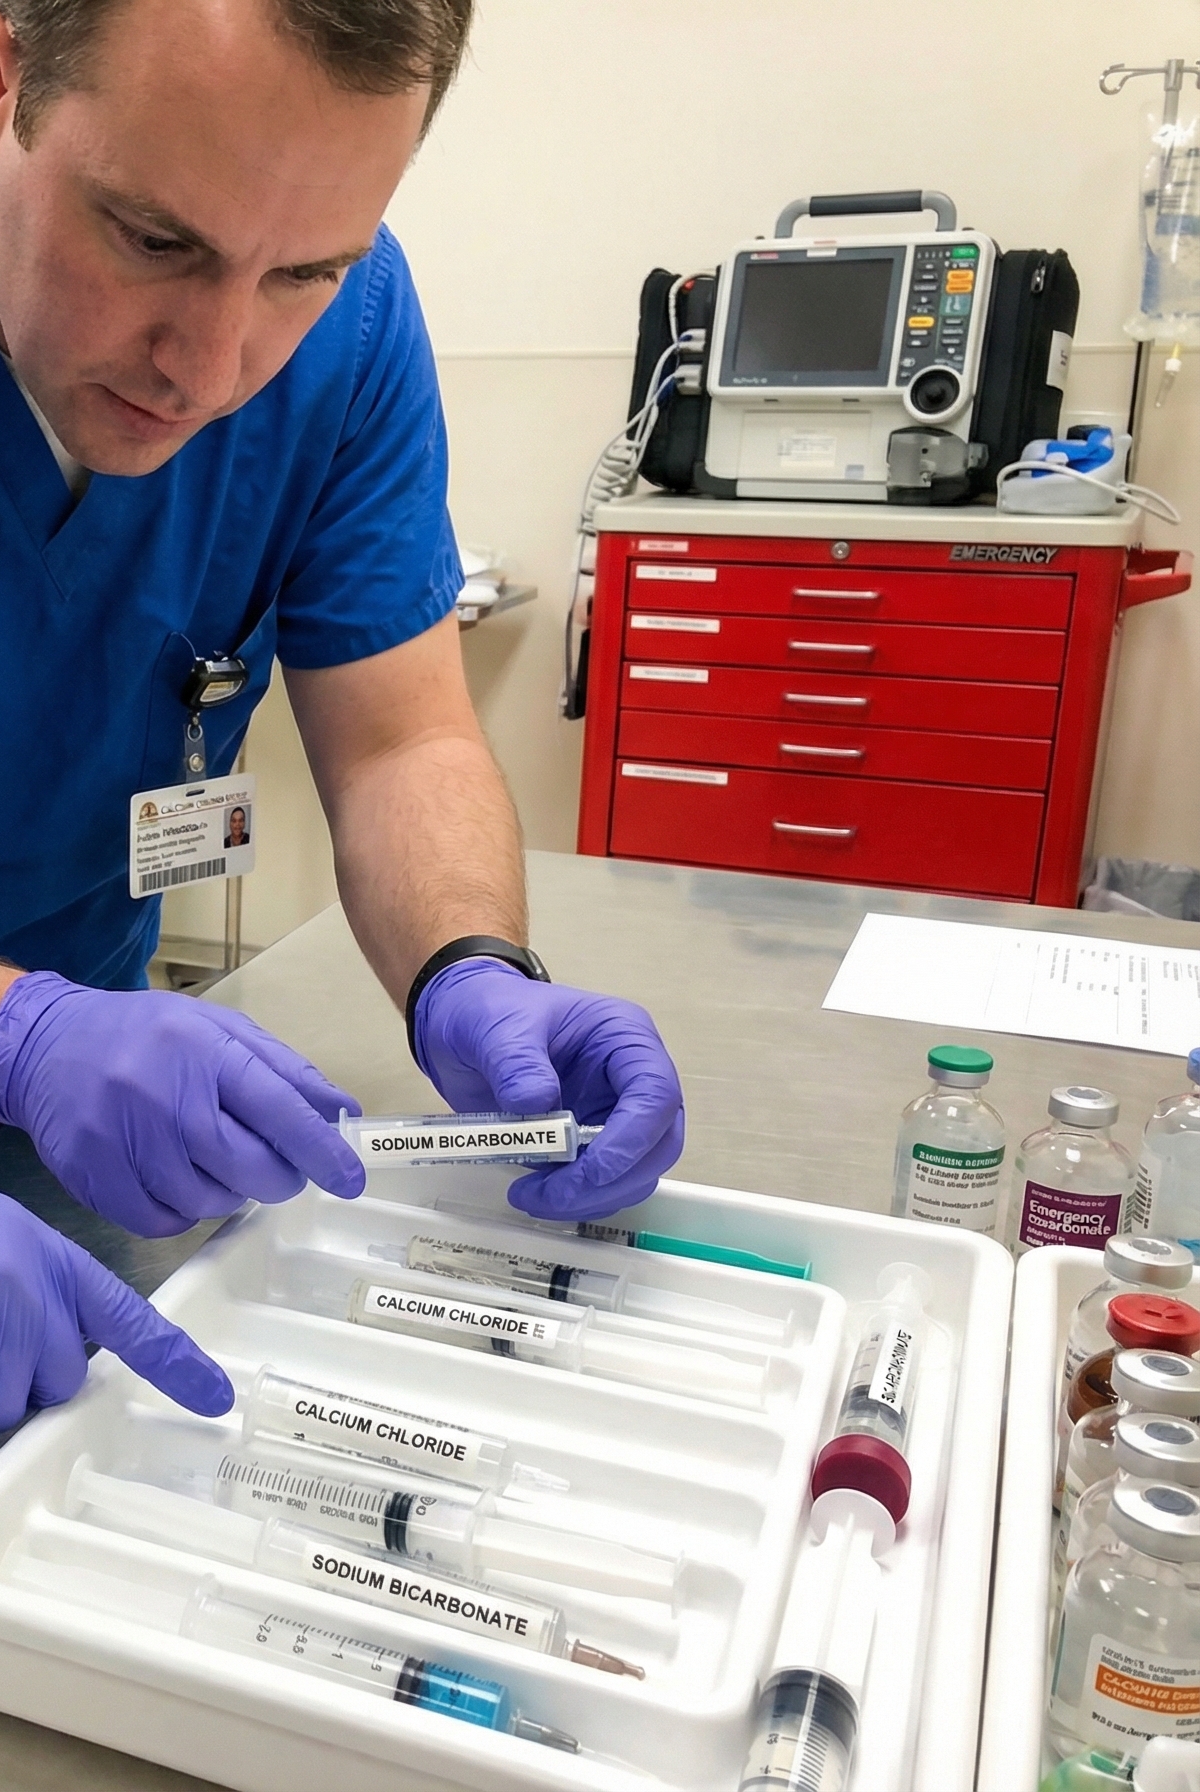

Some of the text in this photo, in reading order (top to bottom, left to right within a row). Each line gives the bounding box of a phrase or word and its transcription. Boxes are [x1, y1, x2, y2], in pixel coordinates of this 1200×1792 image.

[949, 545, 1058, 564] EMERGENCY
[371, 1131, 557, 1152] SODIUM BICARBONATE
[1029, 1199, 1106, 1226] Emergency
[377, 1294, 446, 1318] CALCIUM
[449, 1309, 529, 1335] CHLORIDE
[295, 1400, 466, 1461] CALCIUM CHLORIDE
[312, 1554, 528, 1636] SODIUM BICARBONATE
